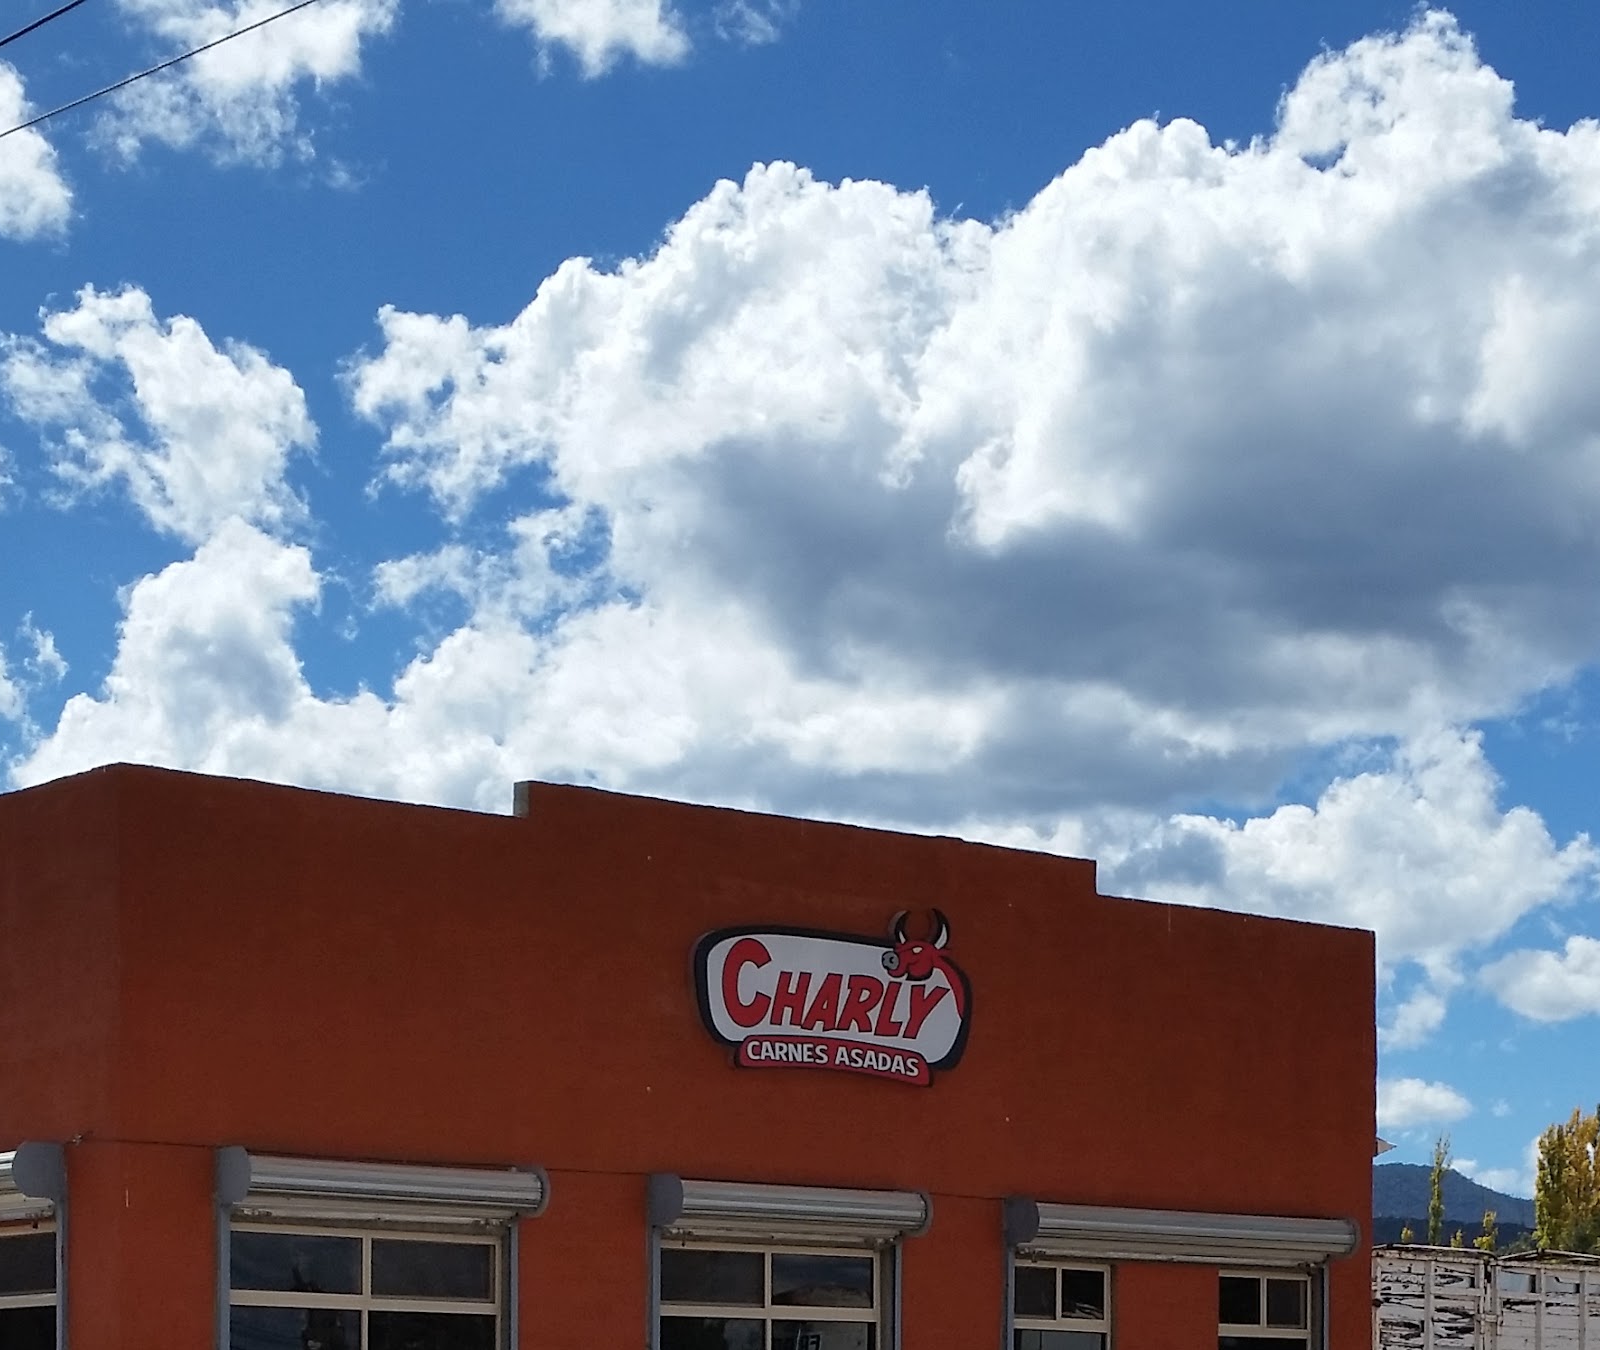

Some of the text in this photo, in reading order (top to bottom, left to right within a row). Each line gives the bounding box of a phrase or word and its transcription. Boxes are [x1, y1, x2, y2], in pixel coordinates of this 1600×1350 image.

[721, 937, 951, 1039] CHARLY
[746, 1040, 920, 1077] CARNES ASADAS
